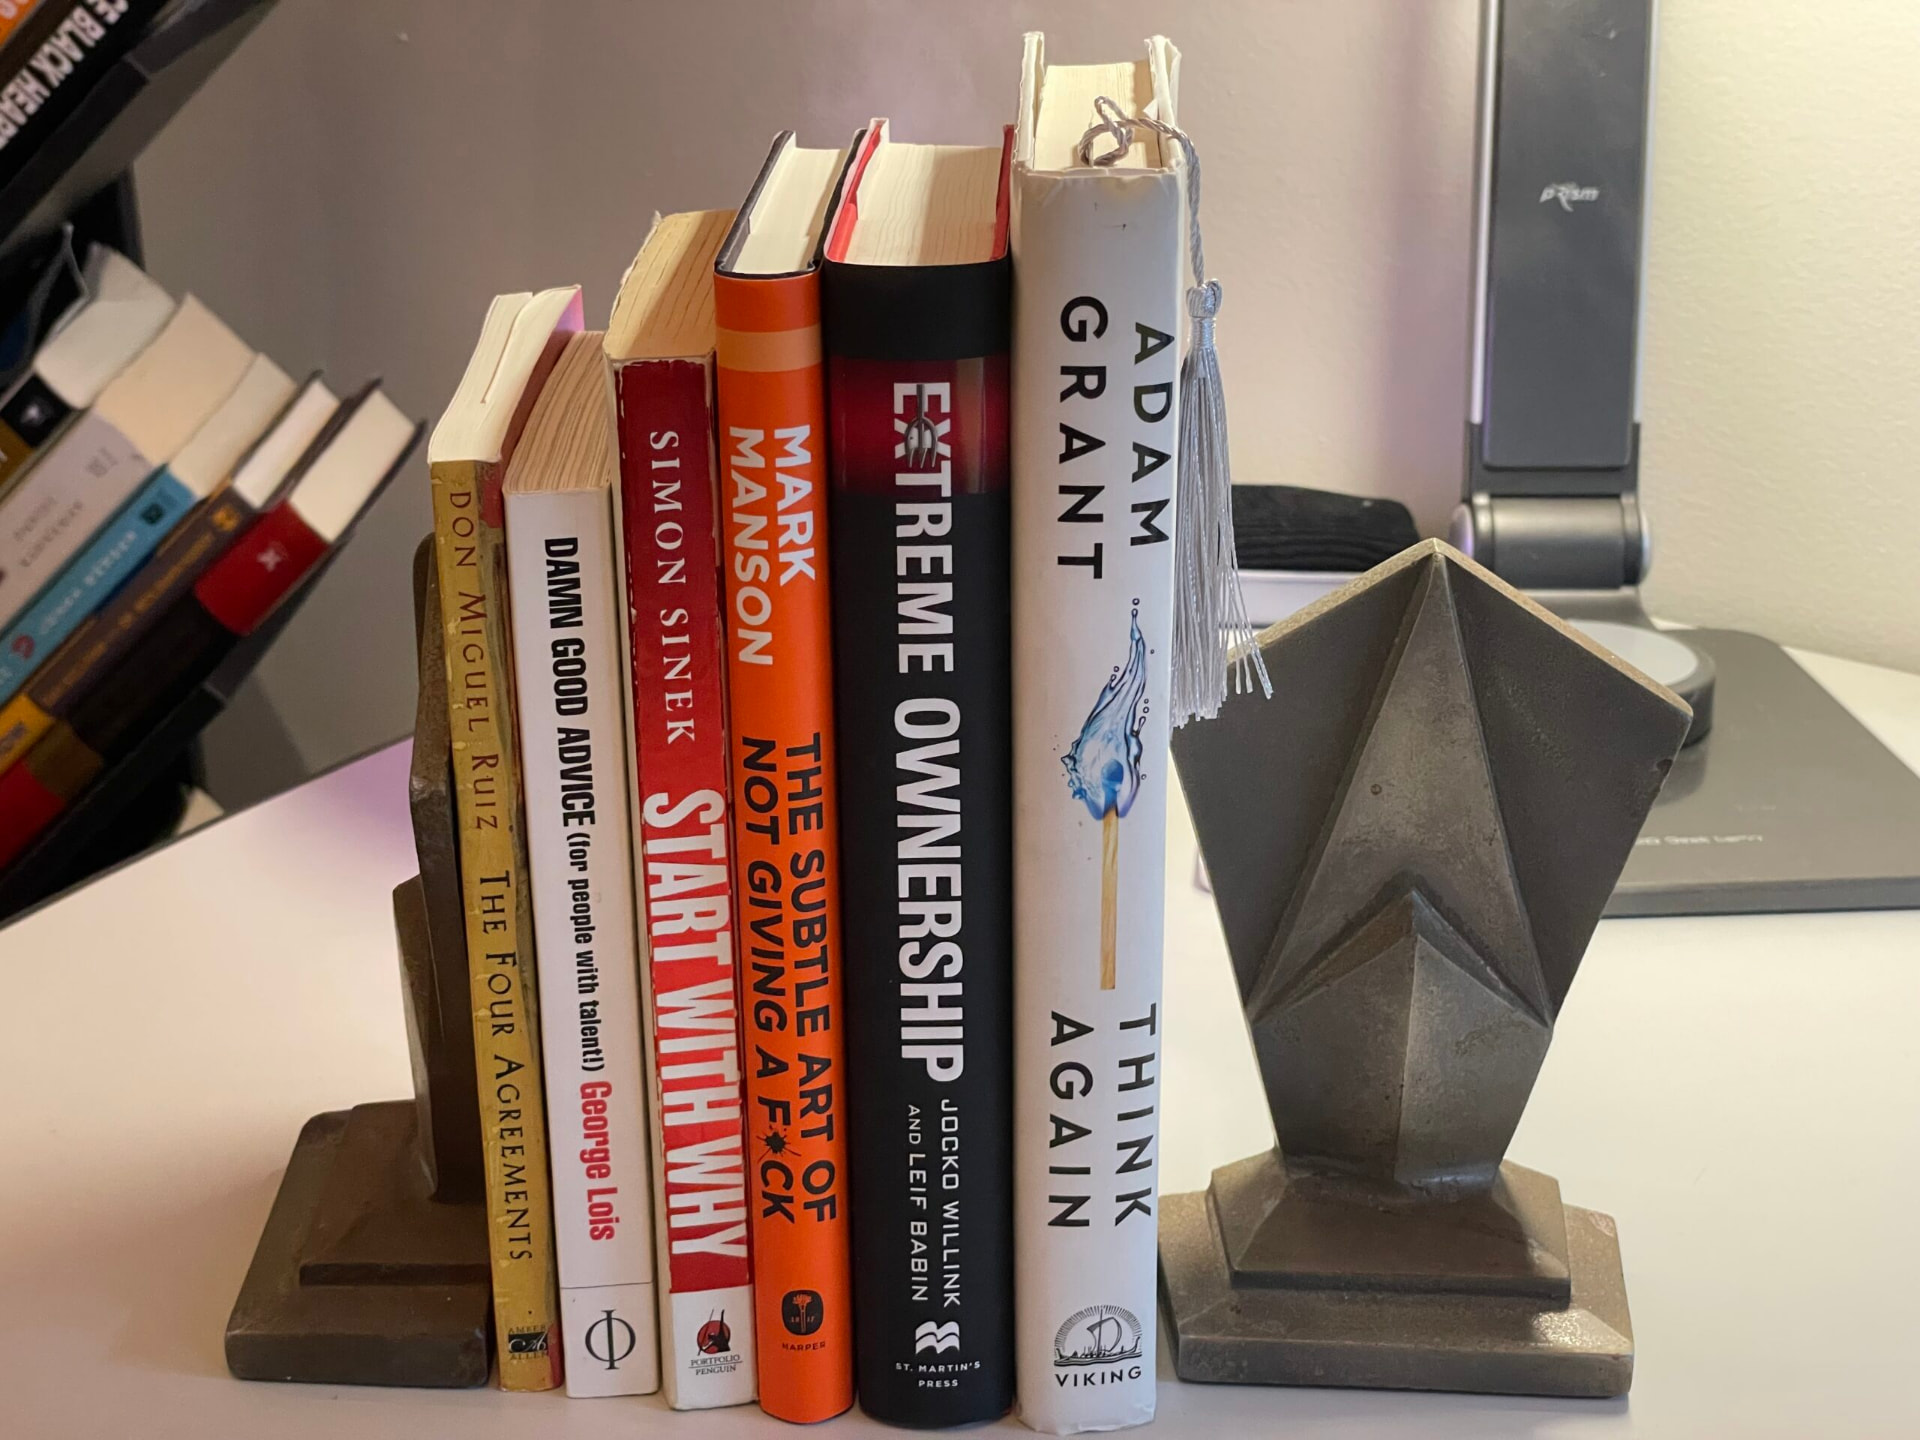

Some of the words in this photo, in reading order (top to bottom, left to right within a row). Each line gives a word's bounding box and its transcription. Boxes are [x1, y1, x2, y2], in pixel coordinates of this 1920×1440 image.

[28, 4, 107, 88] BLACK
[1057, 296, 1108, 579] GRANT
[1130, 322, 1175, 546] ADAM
[450, 491, 477, 567] DON
[650, 430, 686, 584] SIMON
[729, 426, 773, 666] MANSON
[774, 424, 816, 587] MARK
[893, 382, 954, 674] EXTREME
[544, 537, 583, 629] DAMN
[458, 591, 489, 733] MIGUEL
[551, 637, 589, 717] GOOD
[660, 608, 695, 744] SINEK
[471, 753, 500, 830] RUIZ
[557, 727, 596, 827] ADVICE
[742, 736, 780, 845] NOT
[786, 732, 823, 835] THE
[566, 832, 590, 871] (for
[643, 789, 732, 965] START
[894, 697, 964, 1082] OWNERSHIP
[479, 869, 509, 935] THE
[568, 877, 596, 944] people
[747, 860, 788, 1032] GIVING
[789, 849, 830, 1038] SUBTLE
[485, 951, 517, 1037] FOUR
[575, 950, 599, 995] with
[579, 999, 605, 1072] talent!)
[655, 978, 741, 1126] WITH
[755, 1044, 789, 1079] A
[579, 1080, 613, 1179] George
[797, 1053, 834, 1143] ART
[908, 1104, 921, 1145] AND
[941, 1098, 959, 1190] JOCKO
[1047, 1010, 1095, 1228] AGAIN
[1114, 1002, 1157, 1227] THINK
[494, 1054, 533, 1261] AGREEMENTS
[667, 1134, 748, 1257] WHY
[802, 1159, 836, 1223] OF
[909, 1152, 927, 1211] LEIF
[587, 1185, 621, 1242] Lois
[942, 1201, 961, 1308] WILLINK
[910, 1220, 928, 1302] BABIN
[690, 1354, 741, 1367] PORTFOLIO
[695, 1364, 737, 1376] PENGUIN
[782, 1340, 826, 1351] HARPER
[896, 1361, 914, 1373] ST.
[918, 1360, 981, 1374] MARTIN'S
[918, 1378, 959, 1389] PRESS
[1055, 1365, 1142, 1388] VIKING
